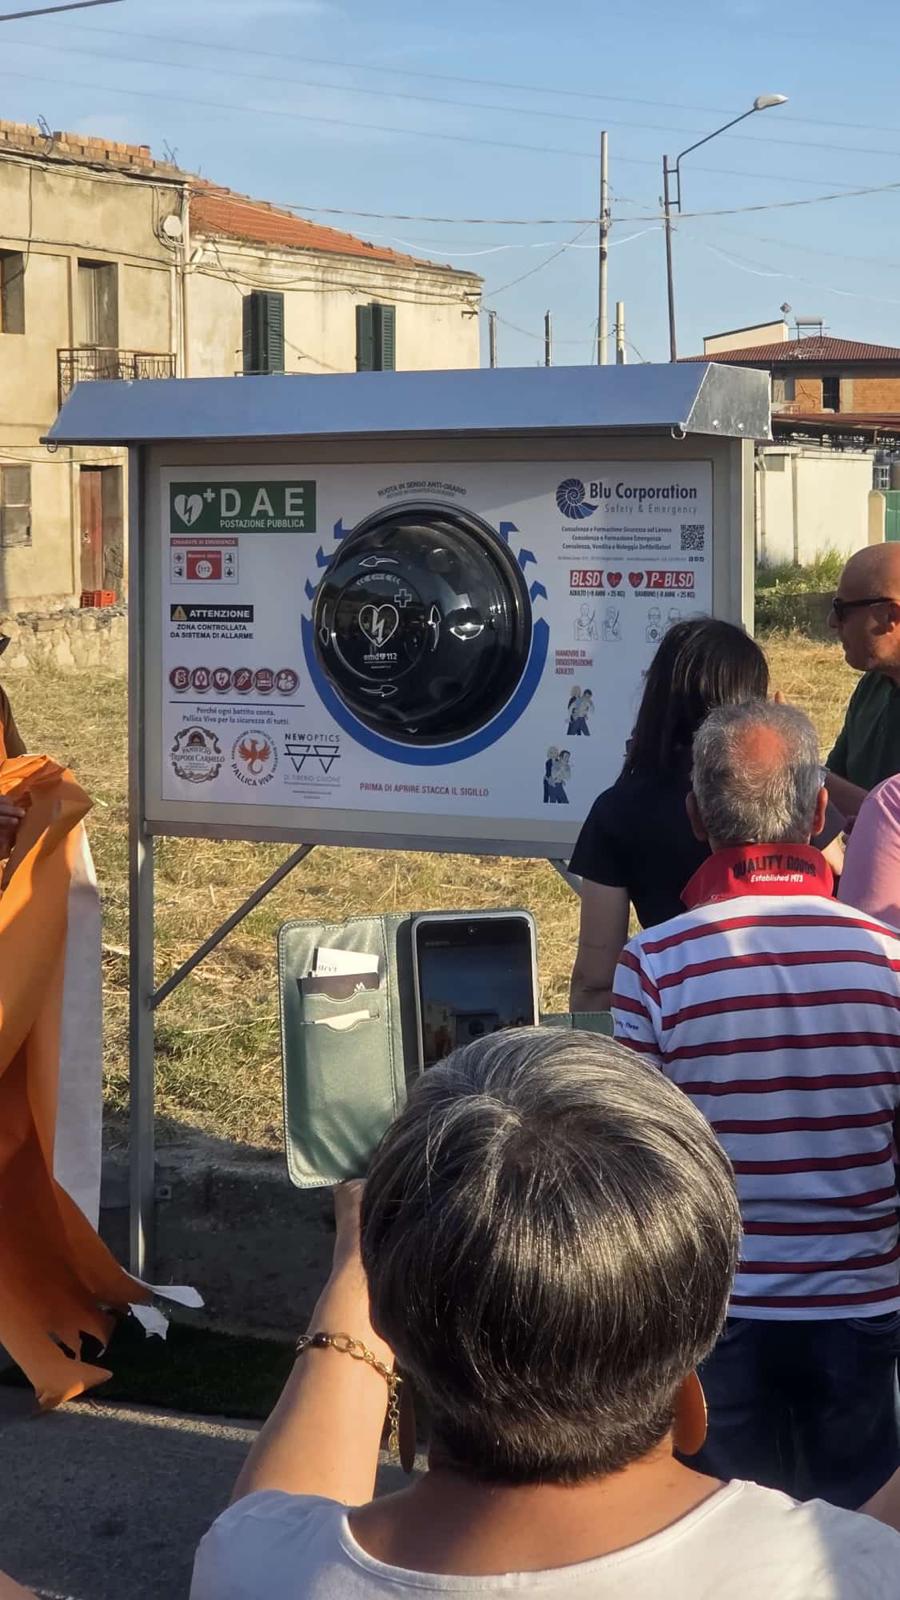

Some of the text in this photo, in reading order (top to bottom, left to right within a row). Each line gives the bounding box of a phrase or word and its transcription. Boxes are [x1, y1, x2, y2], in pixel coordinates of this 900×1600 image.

[589, 481, 698, 503] Blu Corporation
[220, 487, 305, 518] DAE
[603, 503, 698, 516] Safety & Emergency
[220, 519, 305, 529] POSTAZIONE PUBBLICA
[571, 571, 694, 588] BLSD P-BLSD
[189, 609, 250, 618] ATTENZIONE
[217, 708, 232, 716] ogni
[232, 707, 255, 715] battito
[231, 763, 274, 786] PALLICA VIVA
[360, 783, 490, 797] PRIMA DI APRIRE STACCA IL SIGILLO
[733, 855, 817, 880] QUALITY GOODS
[750, 874, 789, 883] Established
